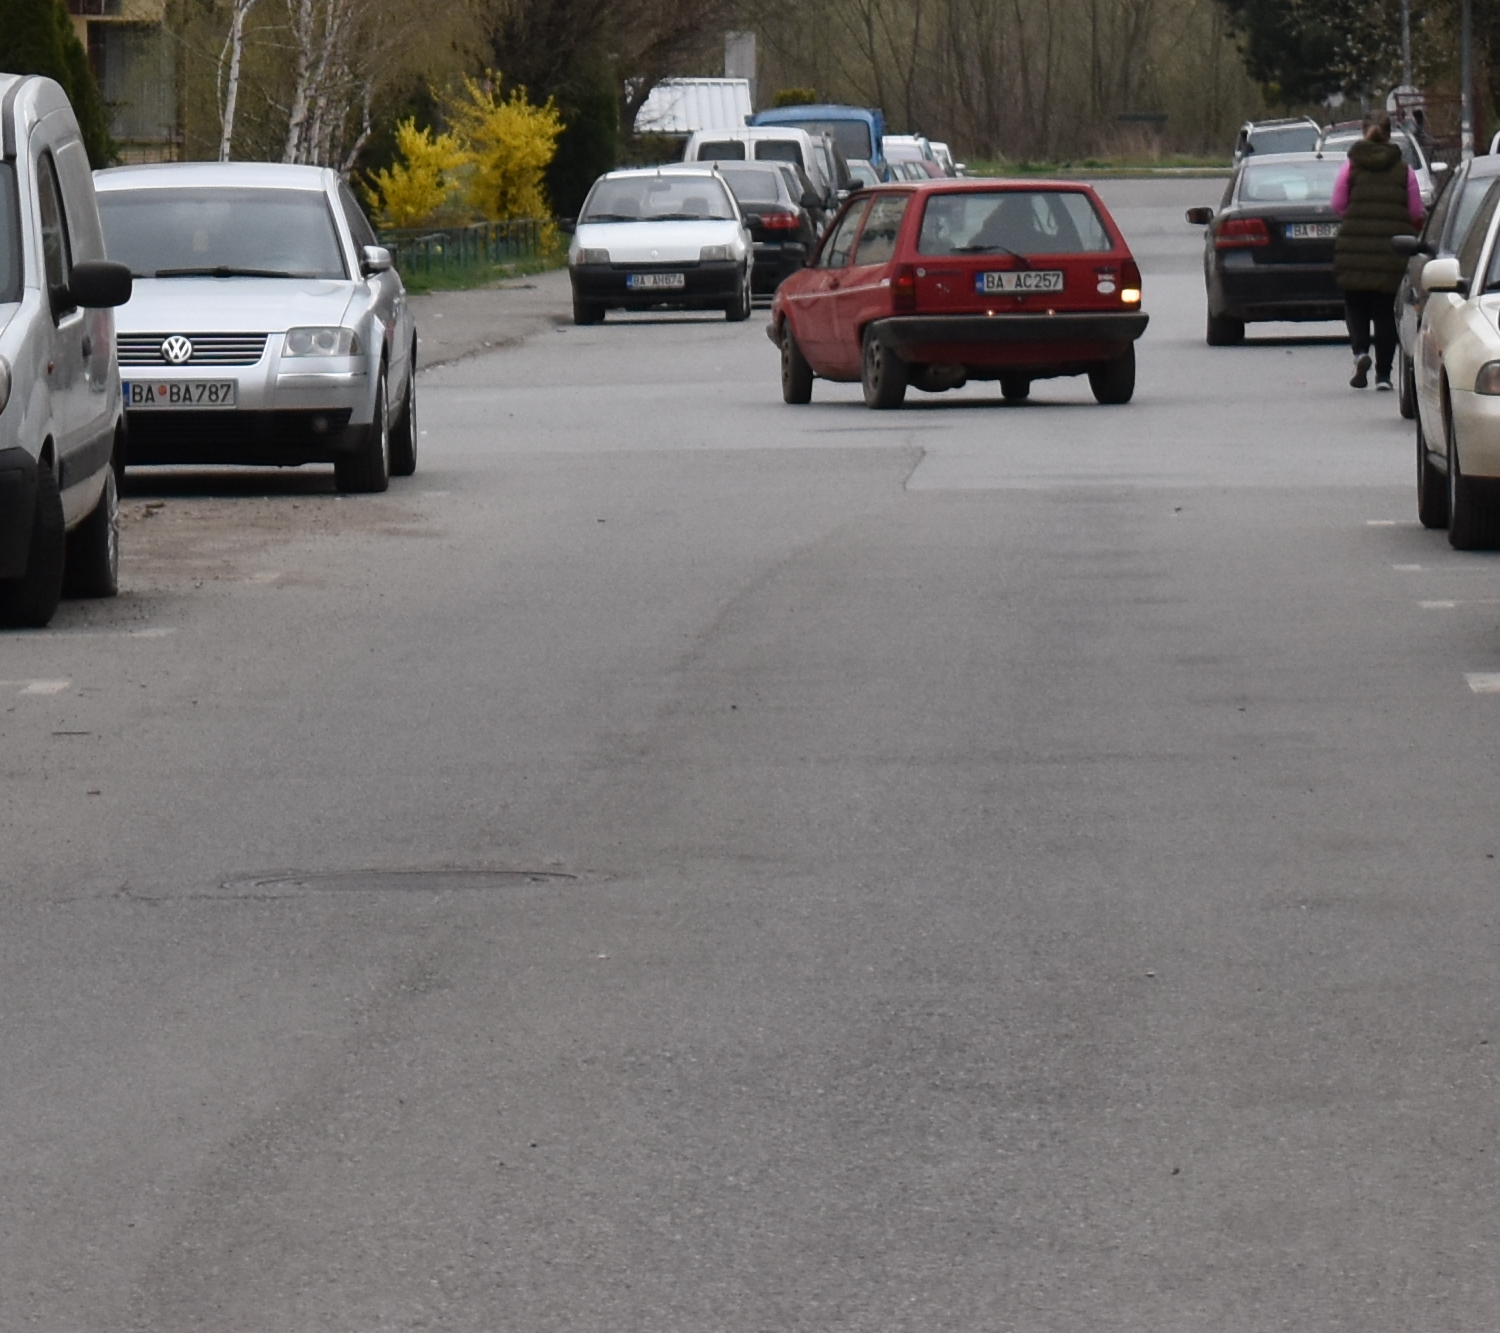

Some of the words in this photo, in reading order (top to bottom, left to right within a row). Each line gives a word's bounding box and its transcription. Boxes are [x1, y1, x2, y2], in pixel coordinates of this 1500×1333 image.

[986, 274, 1004, 289] BA
[1015, 273, 1060, 289] AC257
[132, 384, 155, 403] BA
[169, 384, 231, 403] BA787
